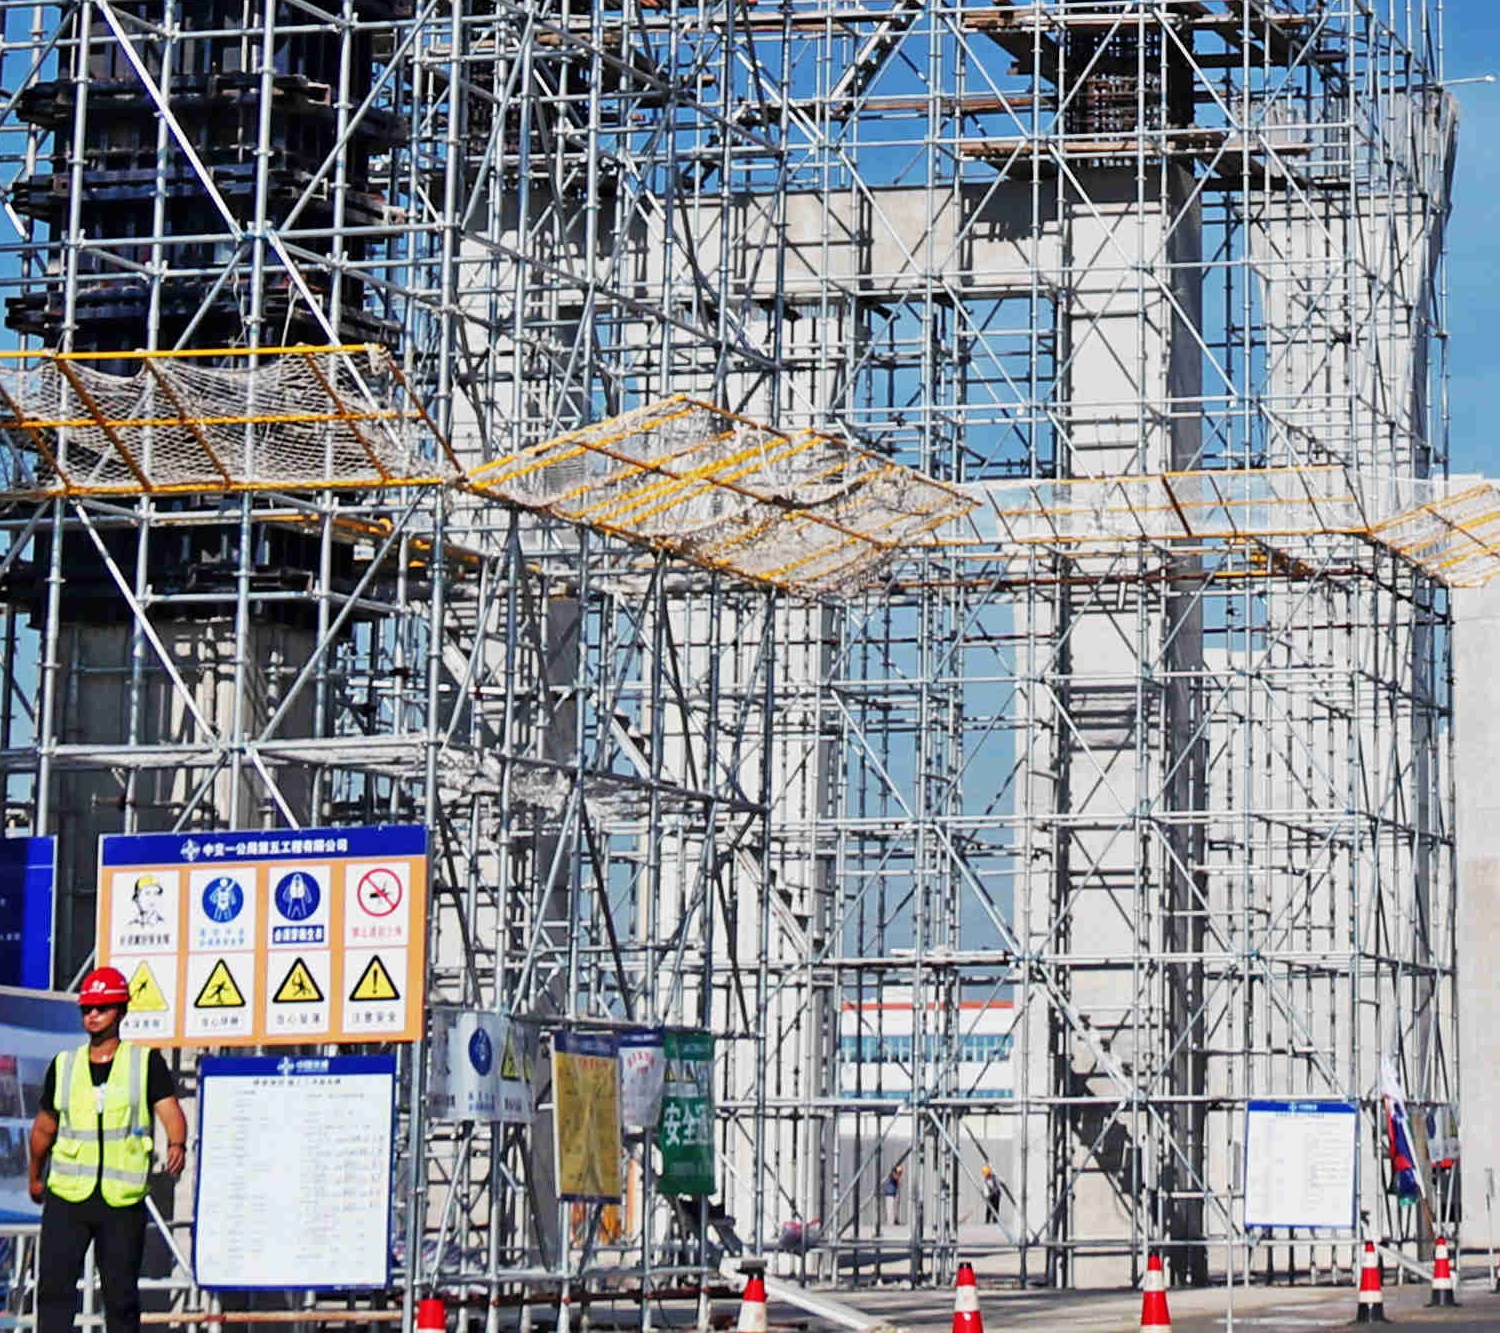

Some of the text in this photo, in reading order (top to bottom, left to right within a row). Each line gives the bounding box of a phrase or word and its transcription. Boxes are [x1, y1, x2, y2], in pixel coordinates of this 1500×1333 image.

[202, 838, 348, 857] 中交一公局第五工程有限公司
